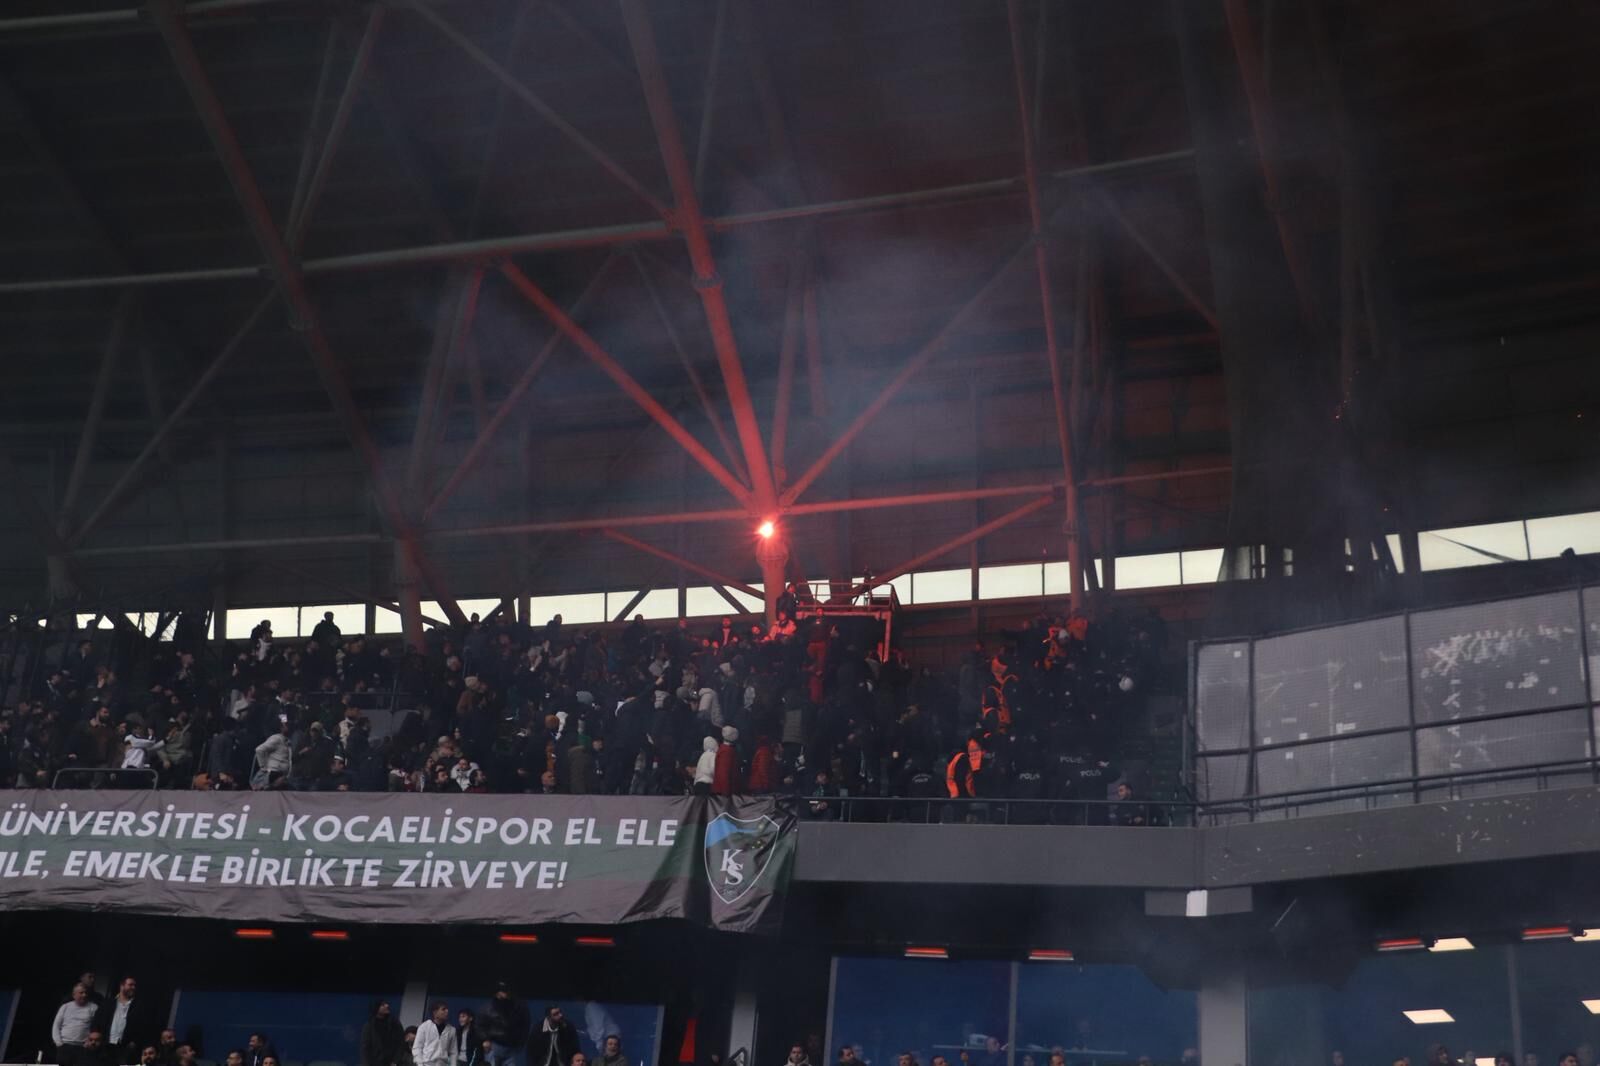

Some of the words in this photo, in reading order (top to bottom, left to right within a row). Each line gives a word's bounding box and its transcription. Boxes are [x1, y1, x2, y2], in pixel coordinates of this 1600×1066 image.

[0, 802, 251, 840] ÜNİVERSİTESİ
[258, 827, 272, 835] -
[282, 807, 553, 846] KOCAELİSPOR
[564, 817, 602, 846] EL
[615, 818, 679, 847] ELE
[0, 850, 49, 880] LE,
[62, 850, 212, 883] EMEKLE
[220, 847, 383, 887] BİRLİKTE
[392, 850, 569, 890] ZİRVEYE!
